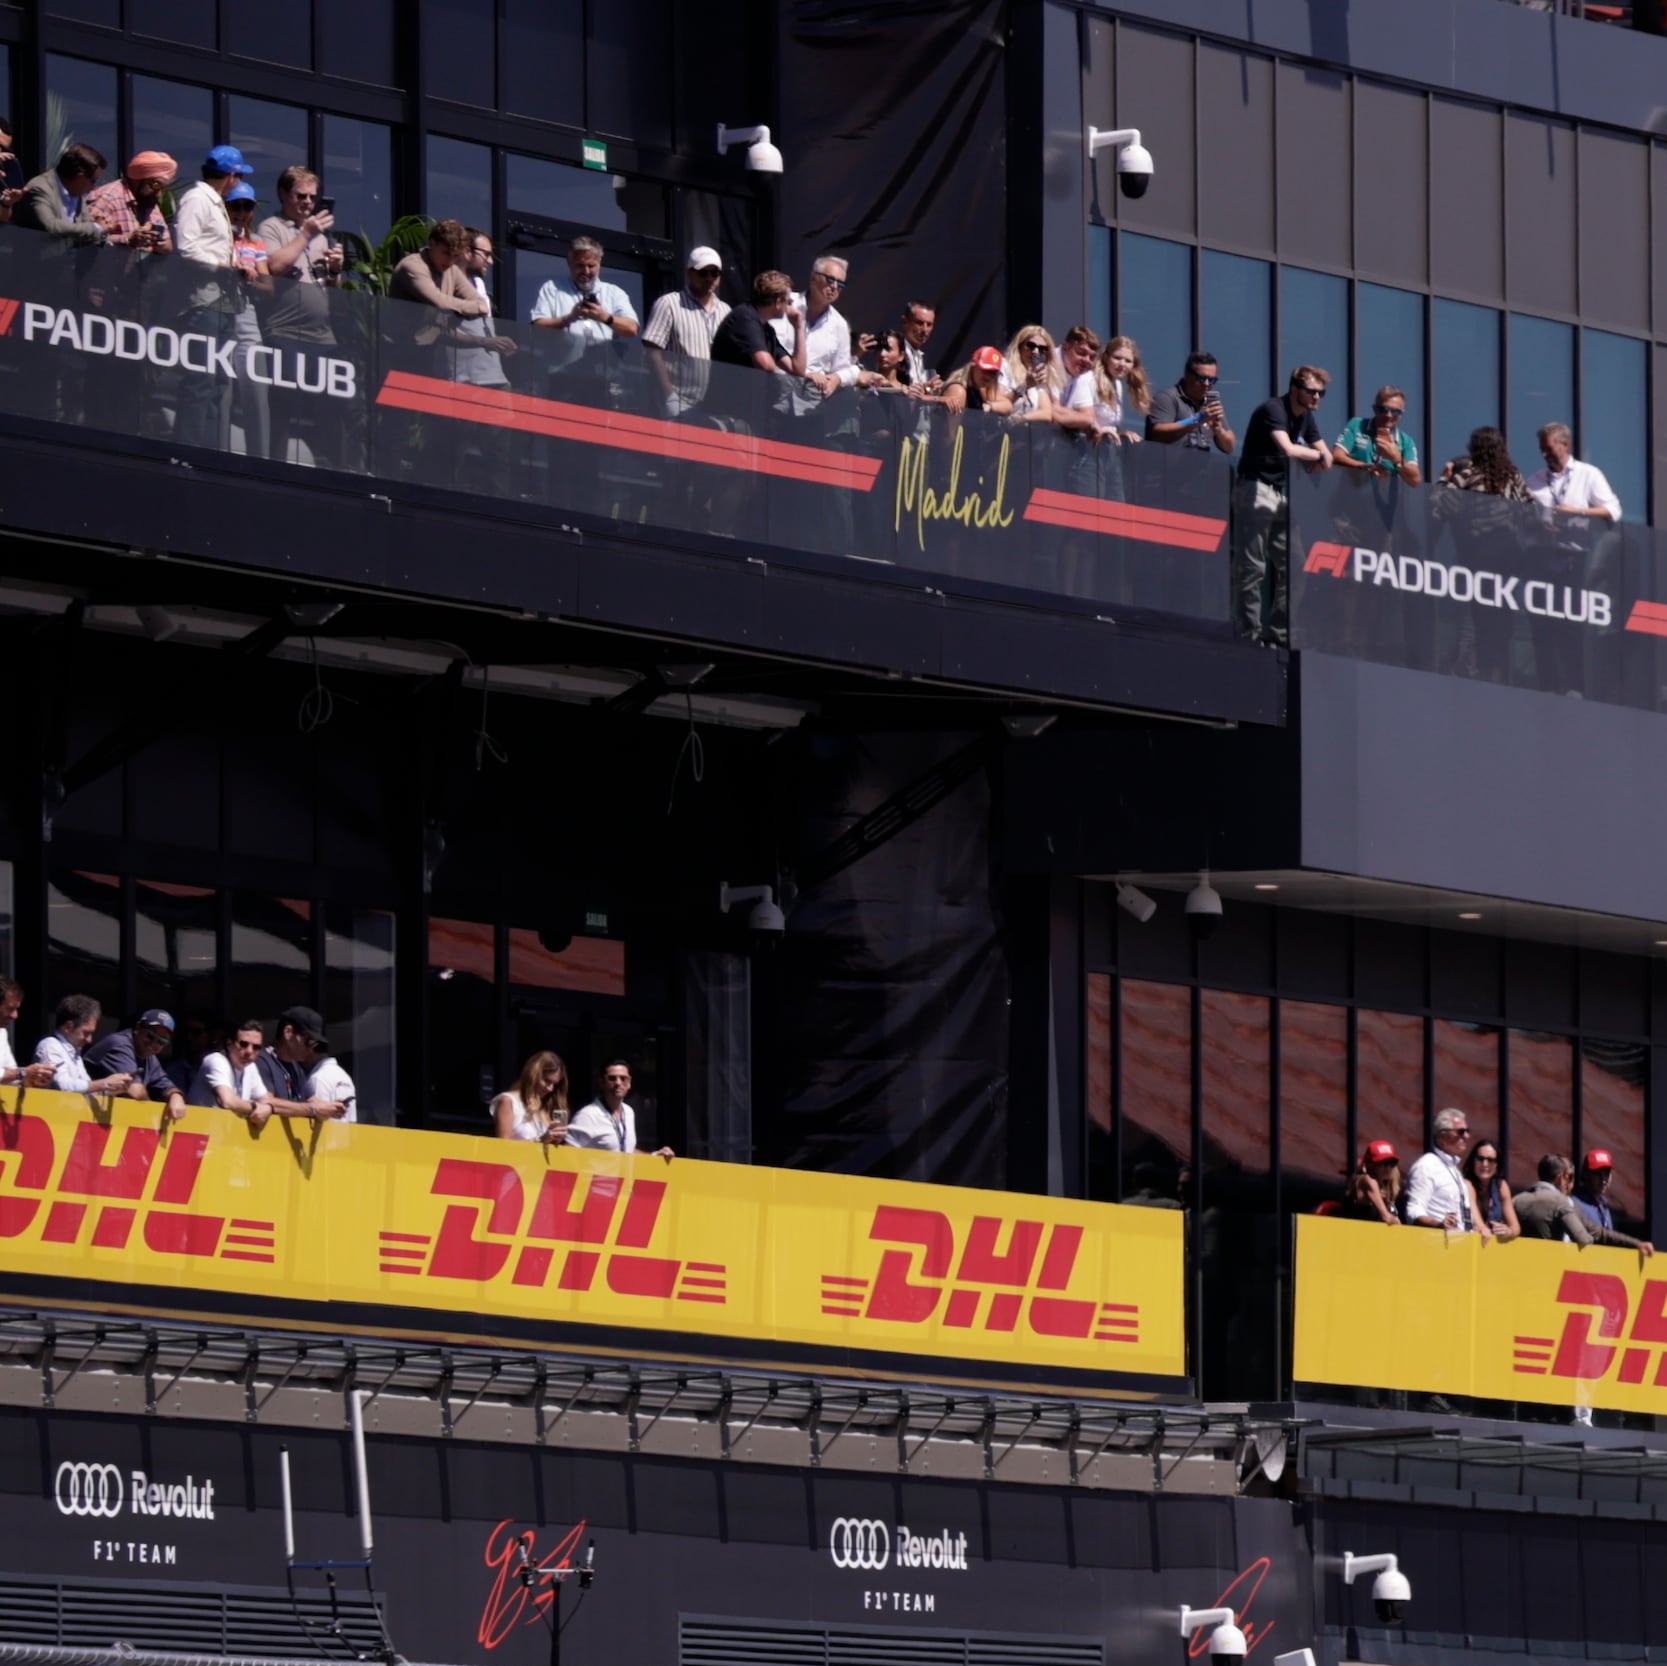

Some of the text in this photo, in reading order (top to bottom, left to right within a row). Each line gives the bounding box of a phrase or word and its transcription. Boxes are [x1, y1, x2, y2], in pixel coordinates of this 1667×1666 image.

[24, 302, 237, 378] PADDOCK
[246, 343, 357, 399] CLUB
[895, 426, 1014, 550] Madrid
[1354, 546, 1520, 611] PADDOCK
[1524, 580, 1612, 627] CLUB
[428, 1157, 683, 1299] DHL
[866, 1204, 1098, 1339] DHL
[132, 1470, 215, 1520] Revolut
[128, 1542, 176, 1565] TEAM
[897, 1526, 968, 1570] Revolut
[893, 1592, 935, 1613] TEAM
